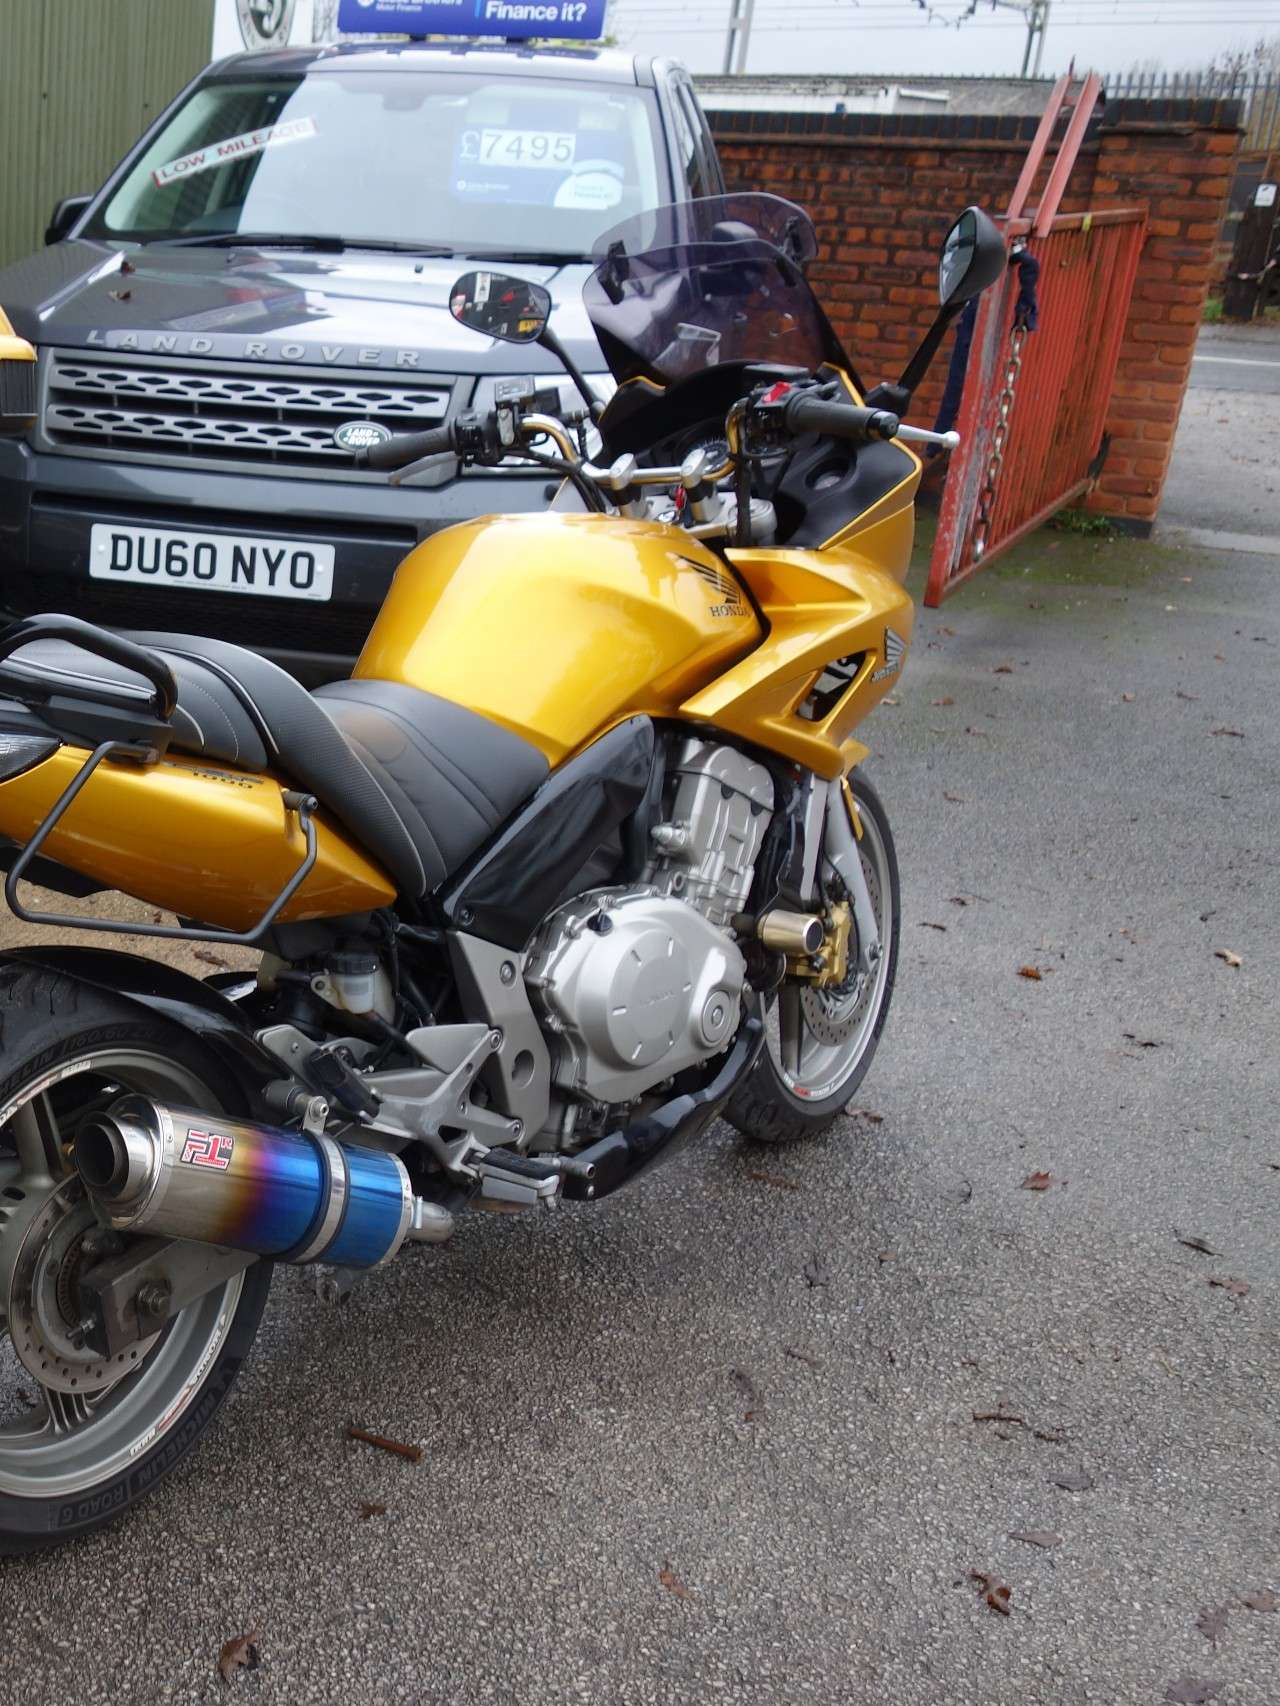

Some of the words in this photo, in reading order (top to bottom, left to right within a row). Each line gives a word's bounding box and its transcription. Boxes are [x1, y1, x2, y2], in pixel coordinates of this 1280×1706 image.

[485, 1, 558, 20] Finance
[561, 3, 587, 21] it?
[162, 153, 205, 178] LOW
[217, 121, 309, 156] MILEAGE
[86, 329, 213, 354] LAND
[244, 342, 422, 367] ROVER
[347, 428, 373, 437] LAND
[110, 534, 217, 580] DU60
[231, 545, 315, 589] NYO
[136, 1394, 217, 1484] MICHELIN
[77, 1486, 124, 1516] ROAD
